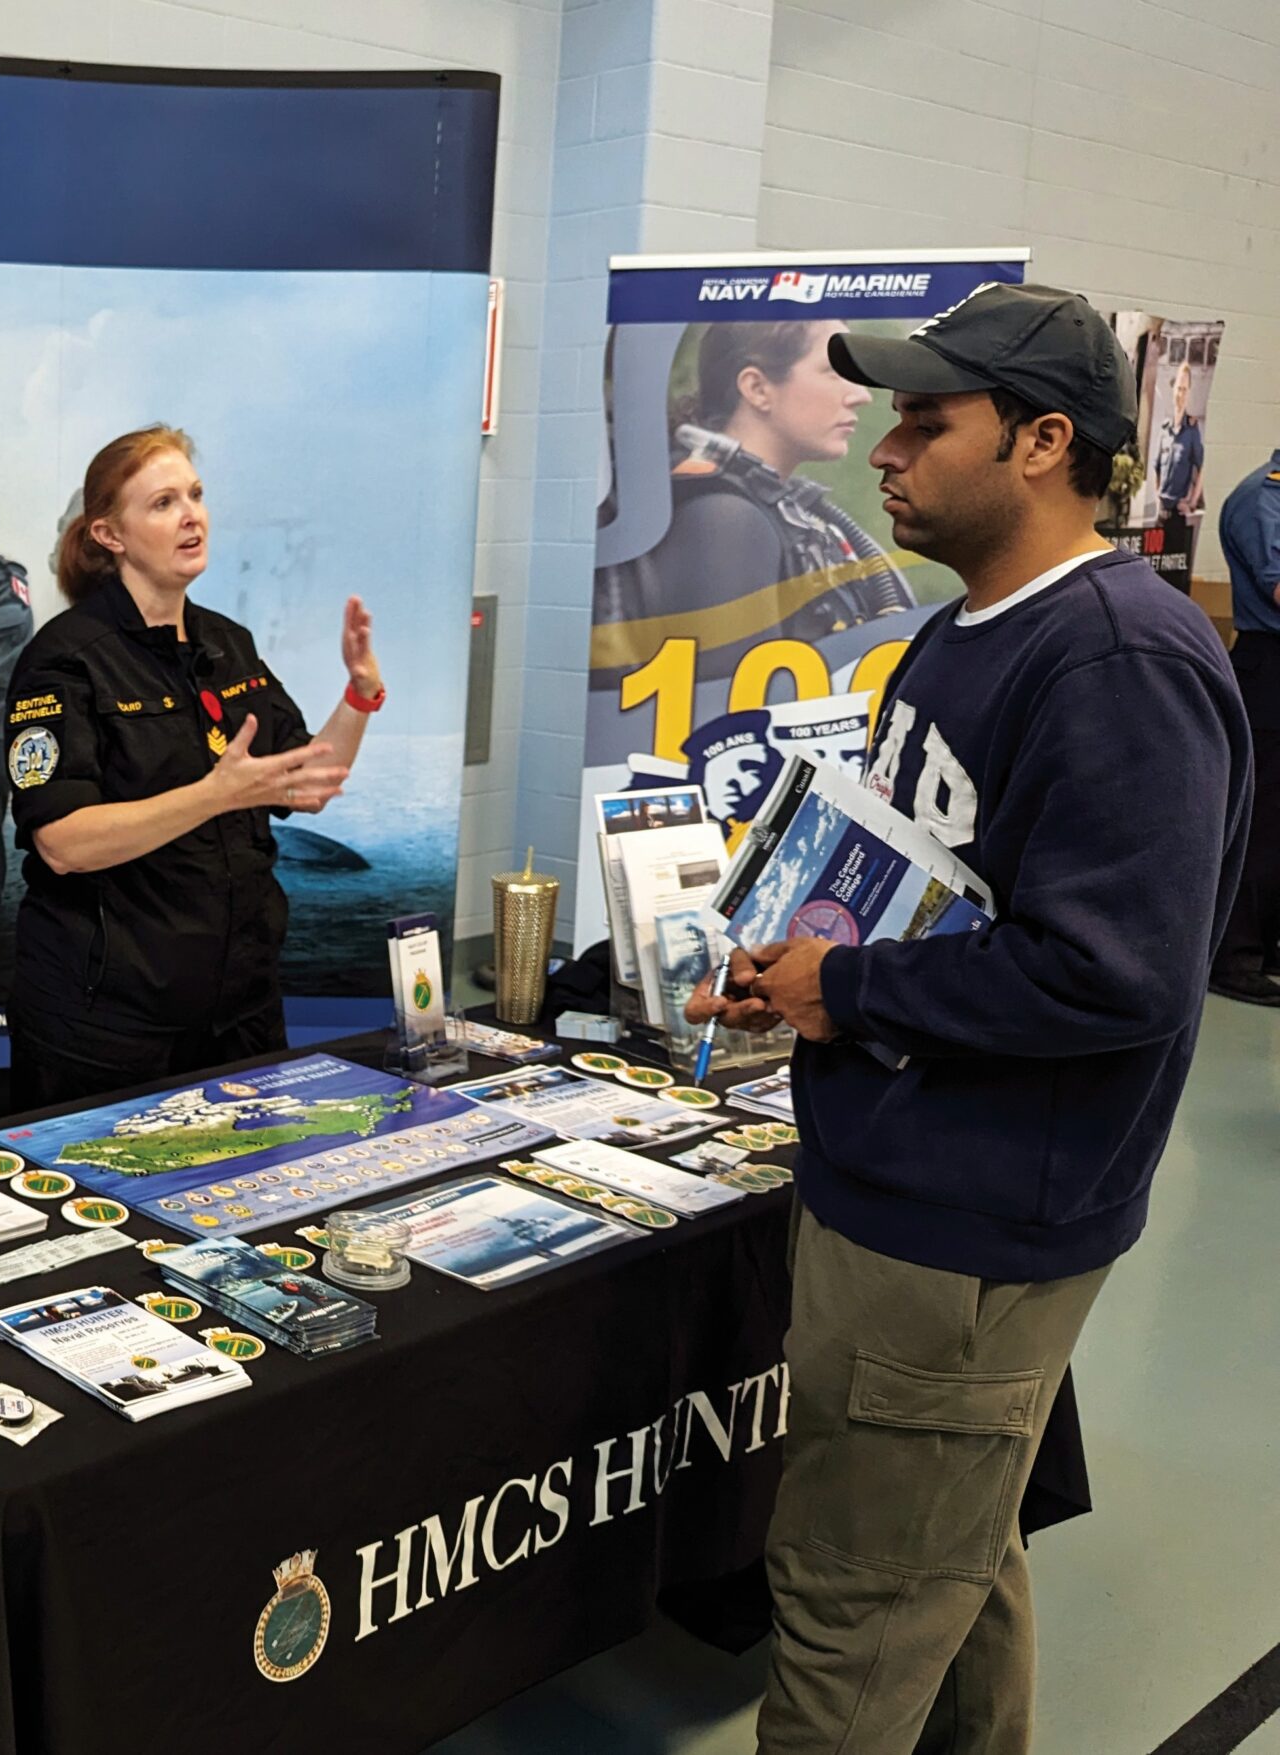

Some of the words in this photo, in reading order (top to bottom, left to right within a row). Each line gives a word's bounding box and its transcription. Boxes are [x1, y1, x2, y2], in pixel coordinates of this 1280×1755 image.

[699, 284, 768, 301] NAVY
[824, 290, 861, 299] ROYALE
[864, 290, 927, 298] CANADIENNE
[826, 274, 931, 292] MARINE
[1144, 528, 1164, 555] 100
[15, 693, 58, 711] SENTINEL
[221, 682, 248, 700] NAVY
[10, 703, 63, 724] SENTINELLE
[789, 726, 812, 739] 100
[812, 717, 861, 736] YEARS
[702, 740, 726, 760] 100
[725, 731, 756, 749] ANS
[795, 766, 812, 794] Canada
[828, 878, 841, 893] The
[838, 843, 862, 878] Canadian
[835, 875, 852, 898] Coast
[848, 851, 866, 876] Guard
[841, 873, 862, 903] College
[39, 1322, 77, 1338] HMCS
[77, 1308, 129, 1328] HUNTER
[51, 1330, 87, 1346] Naval
[87, 1315, 139, 1336] Reserves
[354, 1457, 573, 1642] HMCS
